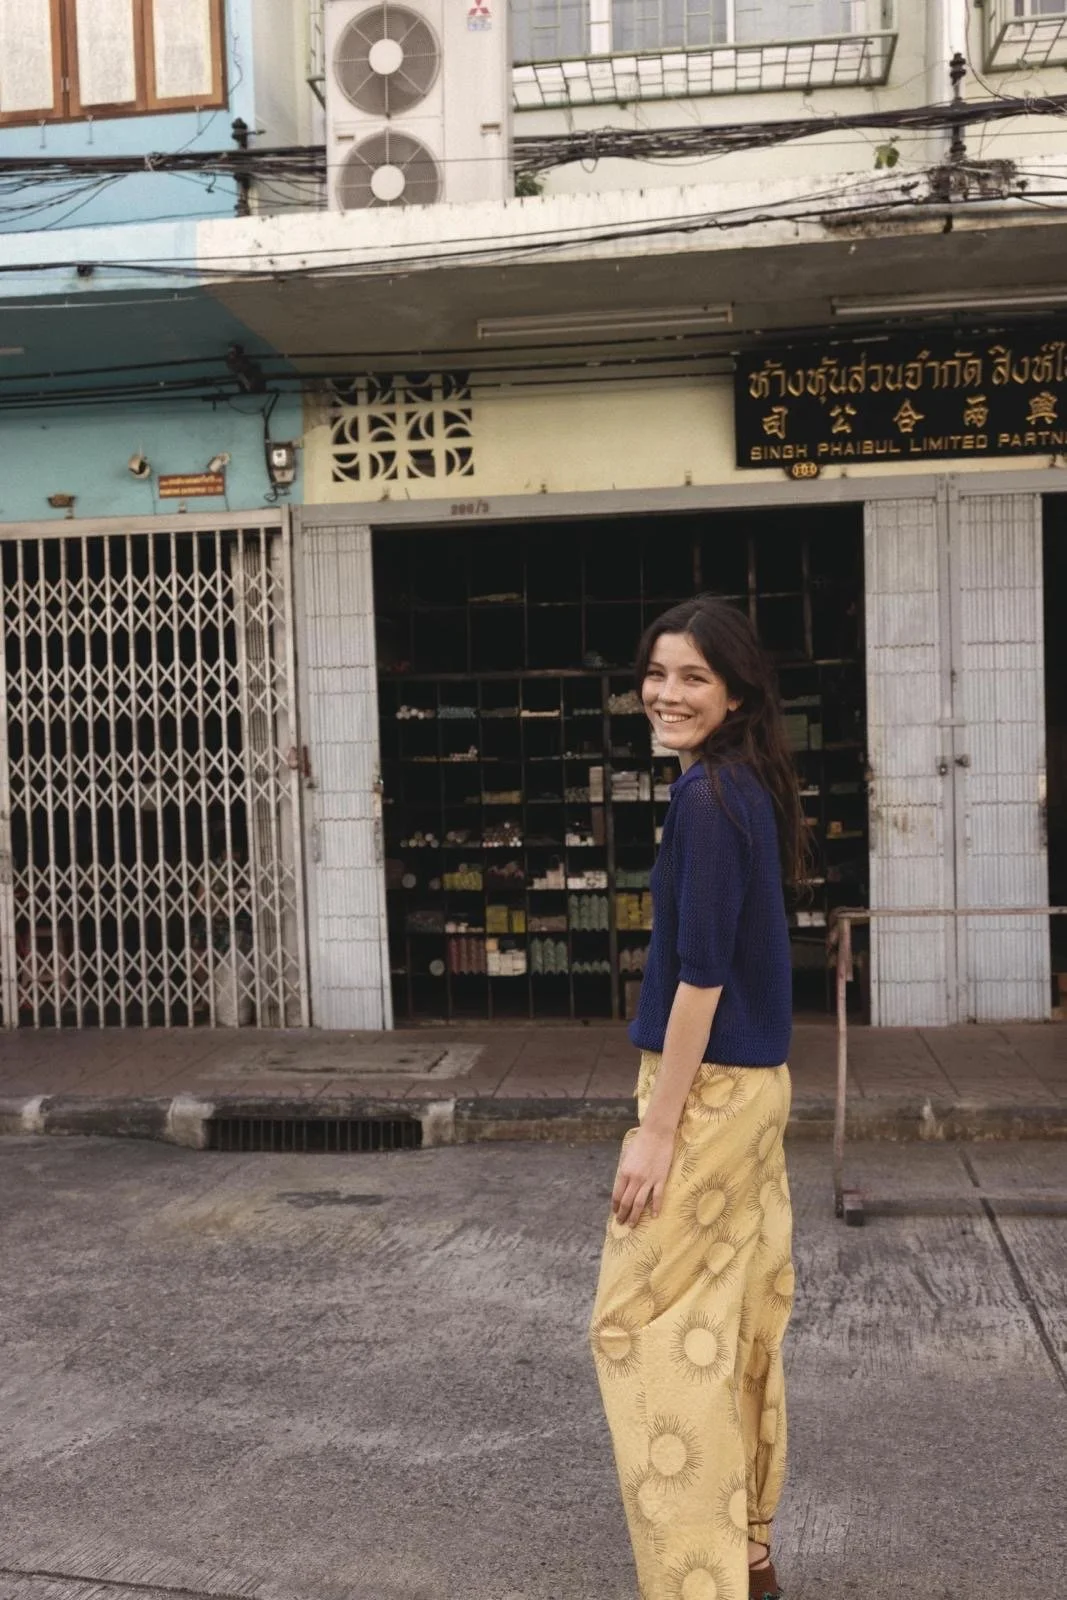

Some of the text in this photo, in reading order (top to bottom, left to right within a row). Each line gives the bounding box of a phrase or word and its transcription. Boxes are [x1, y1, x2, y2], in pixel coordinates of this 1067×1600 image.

[748, 340, 1067, 404] ห้างหุ้นส่วนจำกัด สิงห์ไ
[750, 430, 1067, 460] SINGH PHAIBUL LIMITED PARTN
